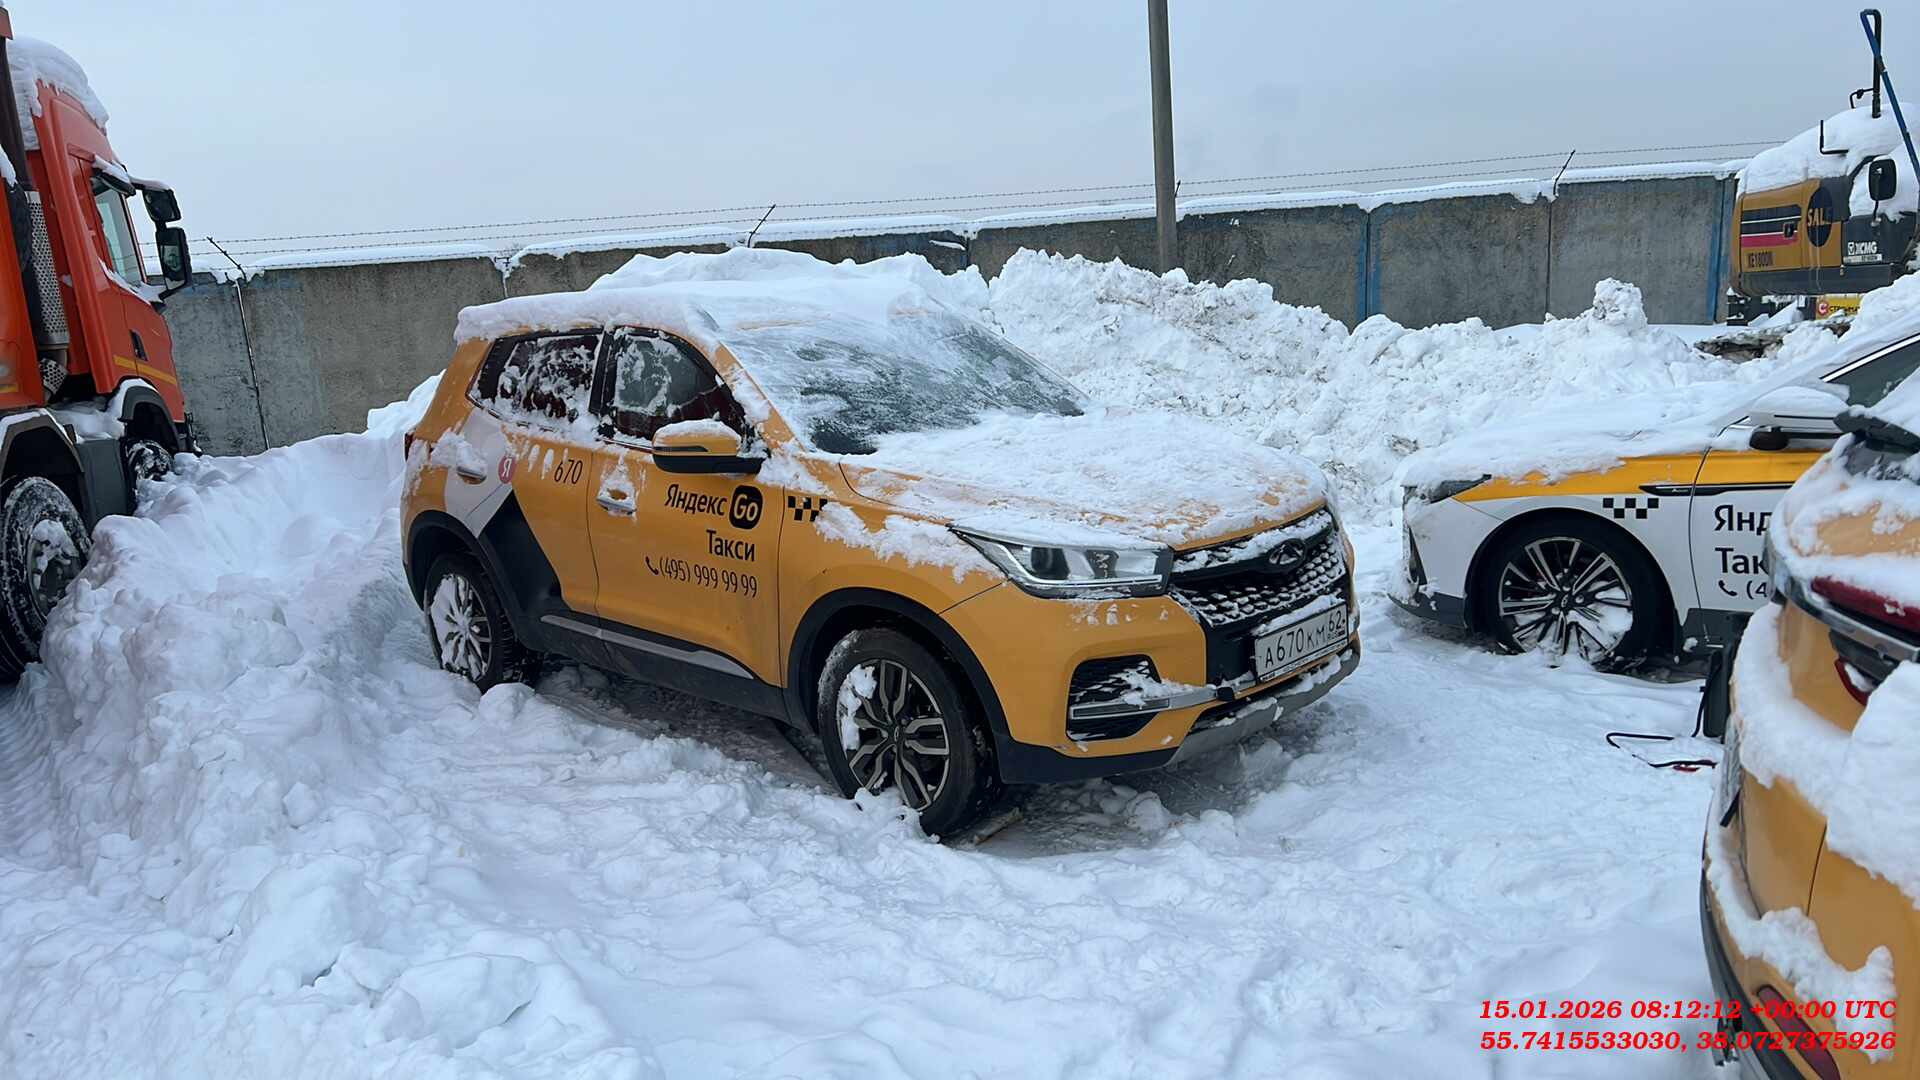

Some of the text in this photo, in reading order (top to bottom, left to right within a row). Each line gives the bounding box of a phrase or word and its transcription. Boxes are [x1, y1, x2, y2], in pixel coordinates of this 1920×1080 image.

[553, 459, 584, 485] 670
[664, 484, 760, 522] Яндекс Go
[706, 529, 756, 562] Такси
[659, 556, 758, 598] (495) 999 99 99
